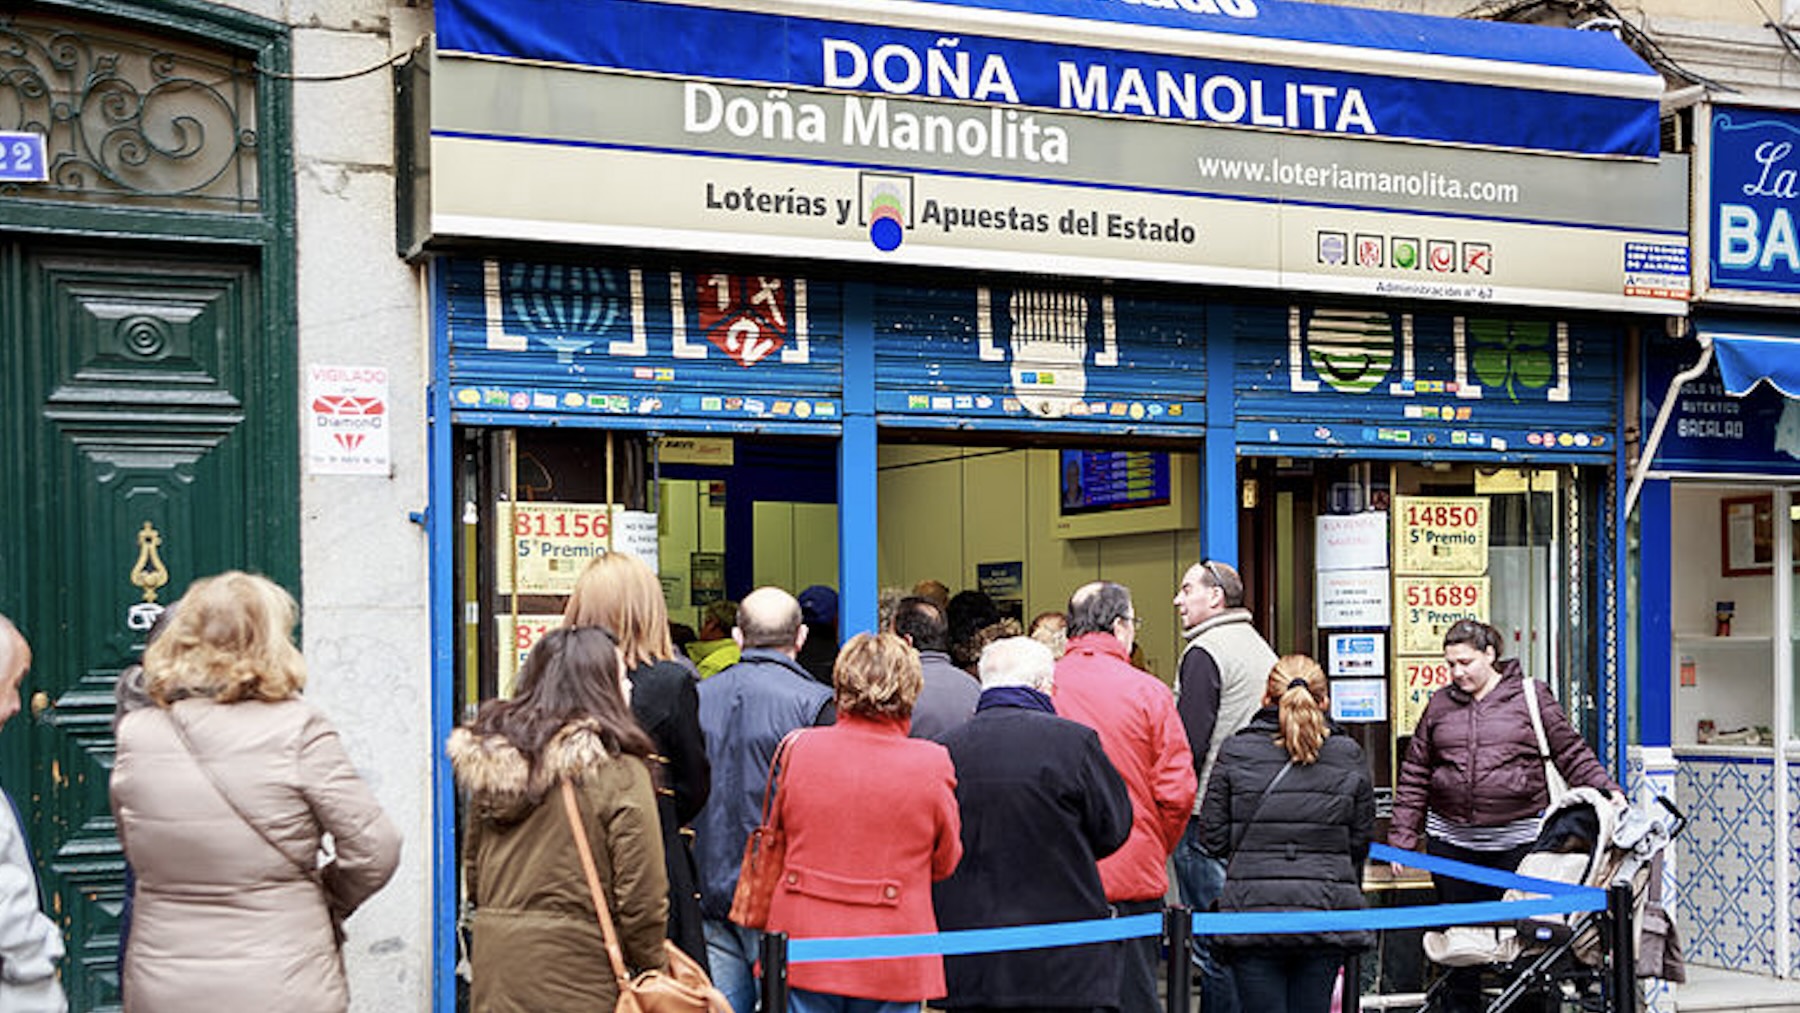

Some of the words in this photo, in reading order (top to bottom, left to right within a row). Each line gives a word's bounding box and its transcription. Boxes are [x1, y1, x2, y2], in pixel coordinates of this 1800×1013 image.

[822, 37, 1020, 104] DOÑA
[1058, 60, 1377, 134] MANOLITA
[684, 82, 827, 143] Doña
[843, 95, 1069, 164] Manolita
[1198, 157, 1519, 203] www.loteriamanolita.com
[1743, 141, 1799, 198] La
[706, 183, 828, 217] Loterías
[836, 199, 852, 225] y
[921, 199, 1049, 232] Apuestas
[1059, 208, 1098, 237] del
[1107, 213, 1196, 244] Estado
[313, 368, 385, 384] VIGILADO
[1678, 418, 1743, 439] BACALAO
[514, 512, 609, 538] 81156
[1408, 506, 1478, 528] 14850
[1426, 529, 1476, 544] Premio
[541, 542, 606, 558] Premio
[1407, 585, 1477, 607] 51689
[1428, 608, 1476, 623] Premio
